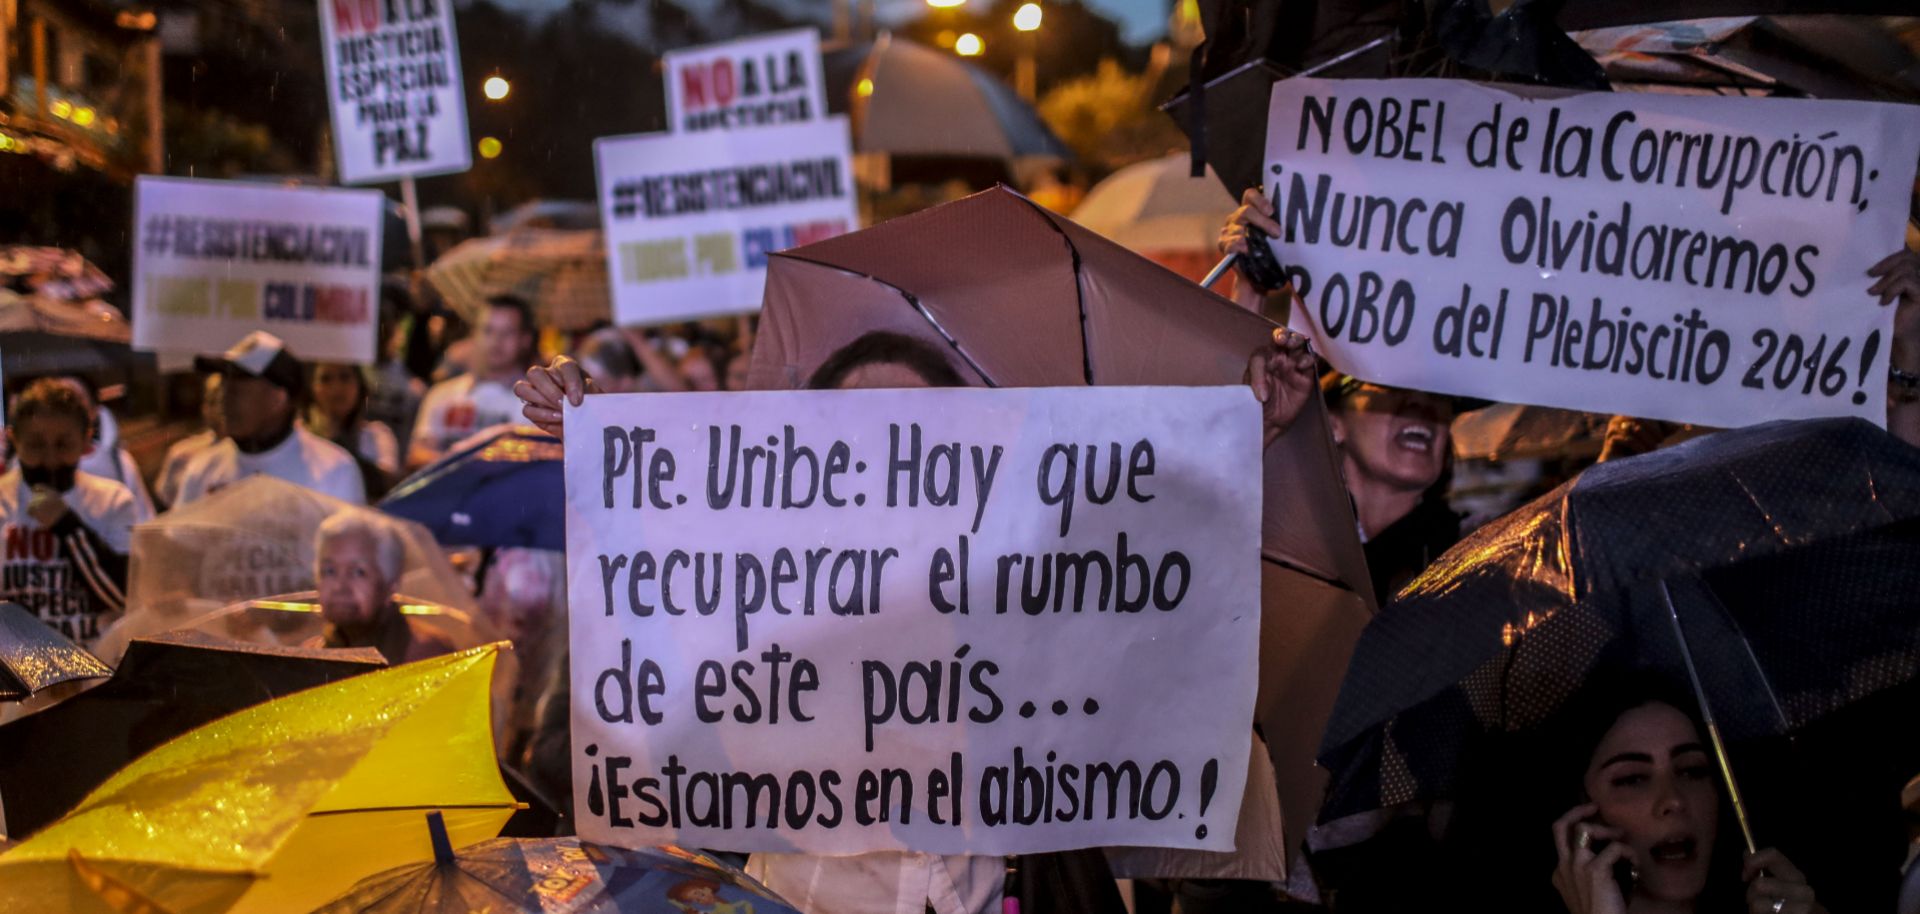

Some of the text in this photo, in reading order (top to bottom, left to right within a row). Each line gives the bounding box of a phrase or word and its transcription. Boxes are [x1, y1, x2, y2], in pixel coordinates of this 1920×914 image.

[681, 51, 804, 109] NO A LA
[374, 122, 431, 166] PAZ
[1297, 95, 1446, 164] NOBEL
[1467, 102, 1530, 170] de
[1540, 107, 1594, 178] la
[1501, 197, 1820, 299] Olvidaremos
[1433, 284, 1509, 360] del
[1524, 293, 1731, 386] Plebiscito
[1741, 328, 1881, 406] 2016!
[708, 424, 867, 511] Uribe:
[886, 423, 1004, 534] Hay
[1037, 438, 1156, 538] que
[7, 524, 54, 561] NO
[598, 531, 1192, 653] recuperar el rumbo
[594, 638, 1100, 753] de este país...
[584, 743, 843, 831] ¡Estamos
[854, 767, 914, 827] en
[927, 751, 963, 828] el
